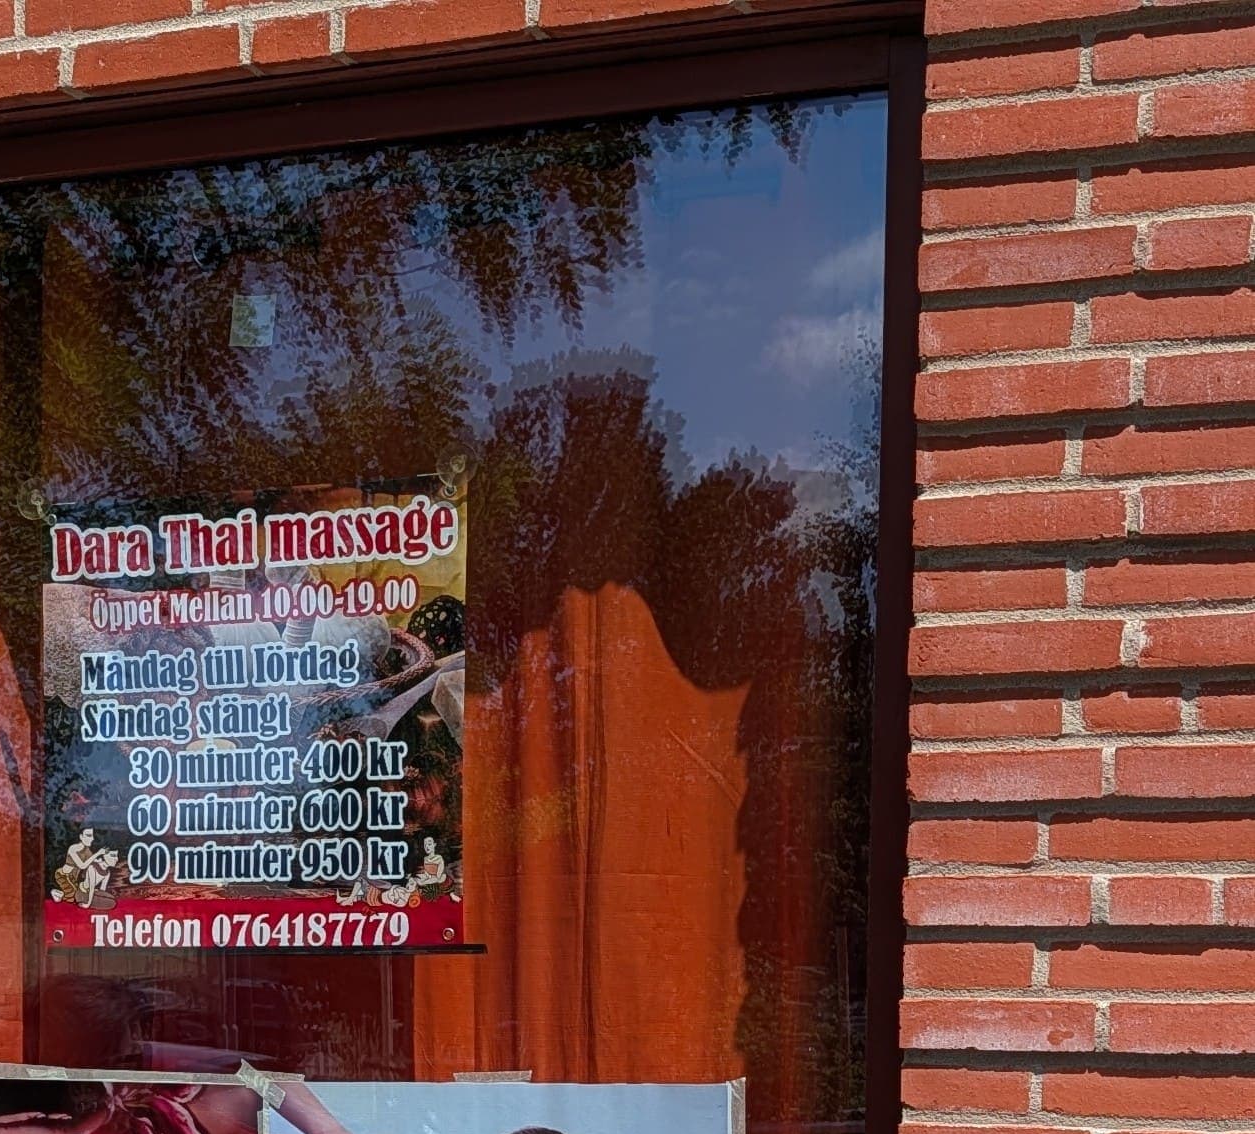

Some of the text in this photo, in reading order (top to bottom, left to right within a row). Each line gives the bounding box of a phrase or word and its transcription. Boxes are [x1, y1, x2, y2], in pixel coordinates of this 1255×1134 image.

[52, 499, 456, 578] Dara Thai massage
[91, 578, 417, 631] Öppet Mellan 10.00-19.00
[82, 651, 195, 693] Måndag
[204, 647, 245, 685] till
[82, 695, 289, 738] Söndag stängt
[131, 740, 406, 787] 30 minuter 400 kr
[129, 789, 407, 834] 60 minuter 600 kr
[129, 838, 407, 881] 90 minuter 950 kr
[91, 911, 410, 948] Telefon 0764187779
